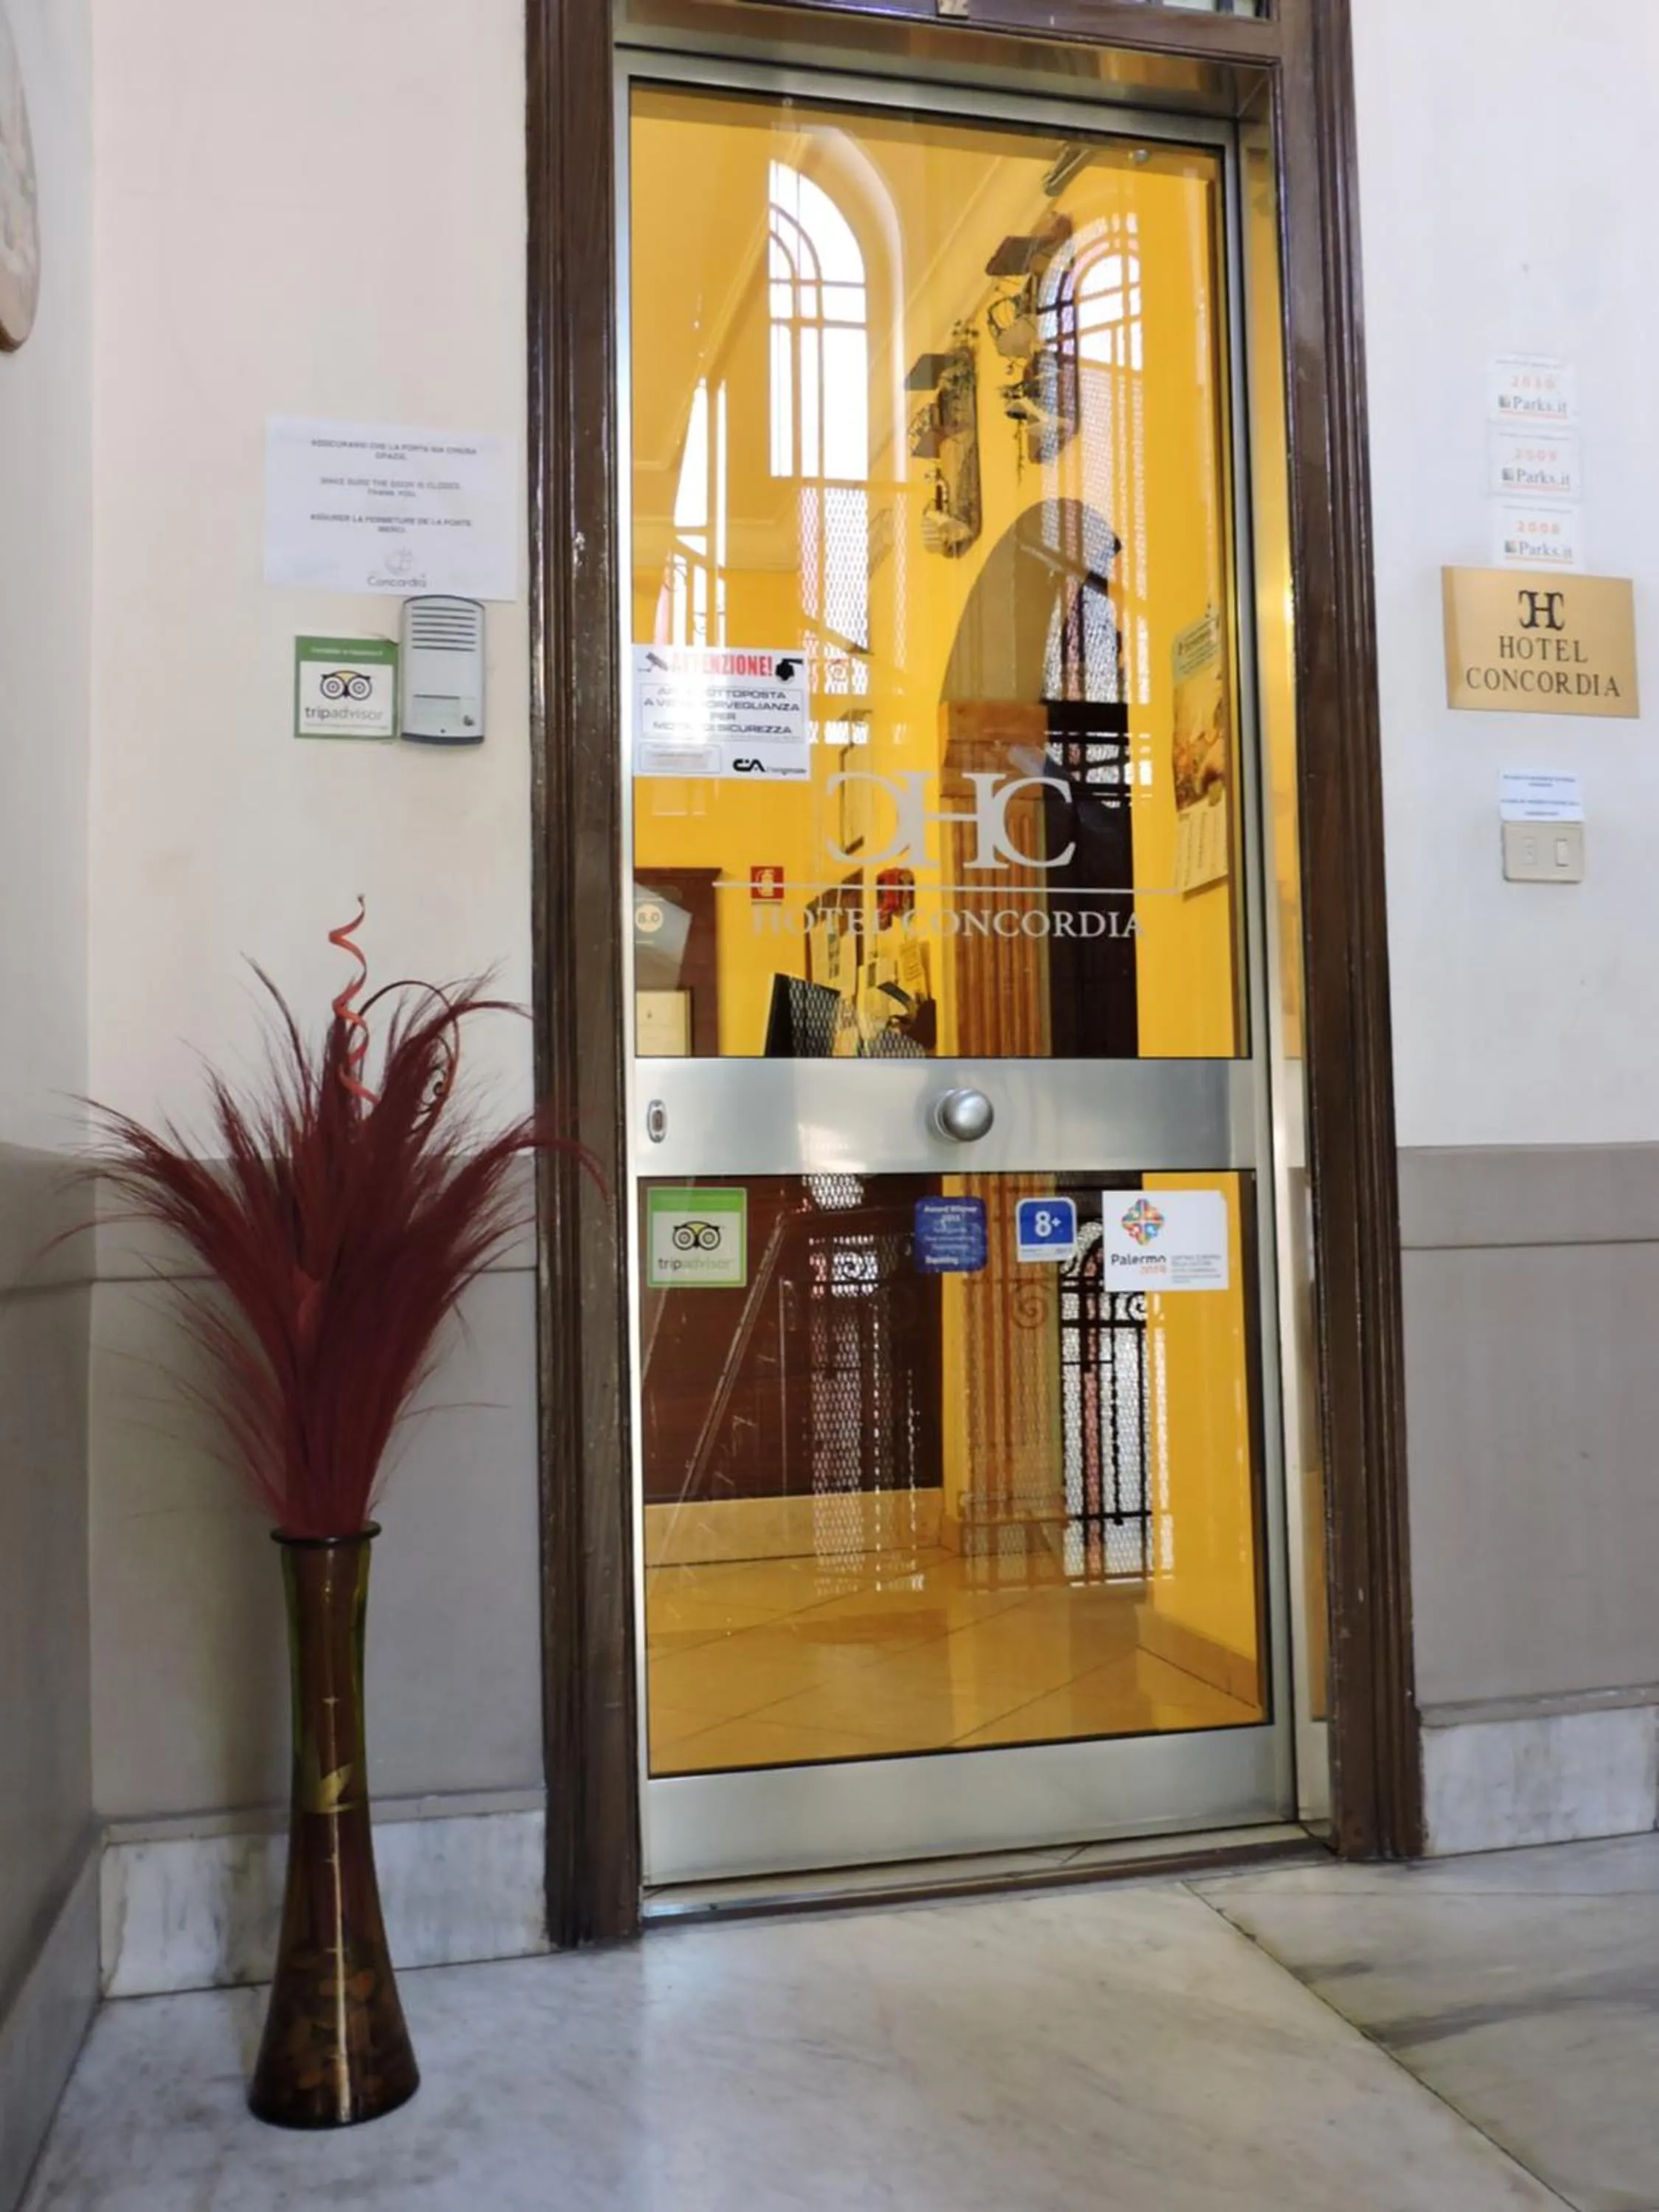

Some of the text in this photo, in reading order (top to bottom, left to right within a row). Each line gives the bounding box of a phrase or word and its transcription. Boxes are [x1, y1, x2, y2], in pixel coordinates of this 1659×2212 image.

[1499, 636, 1588, 663] HOTEL
[698, 688, 787, 700] OTTOPOSTA
[1466, 667, 1621, 698] CONCORDIA
[752, 906, 1144, 938] HOTEL CONCORDIA
[1110, 1253, 1166, 1266] Palermo
